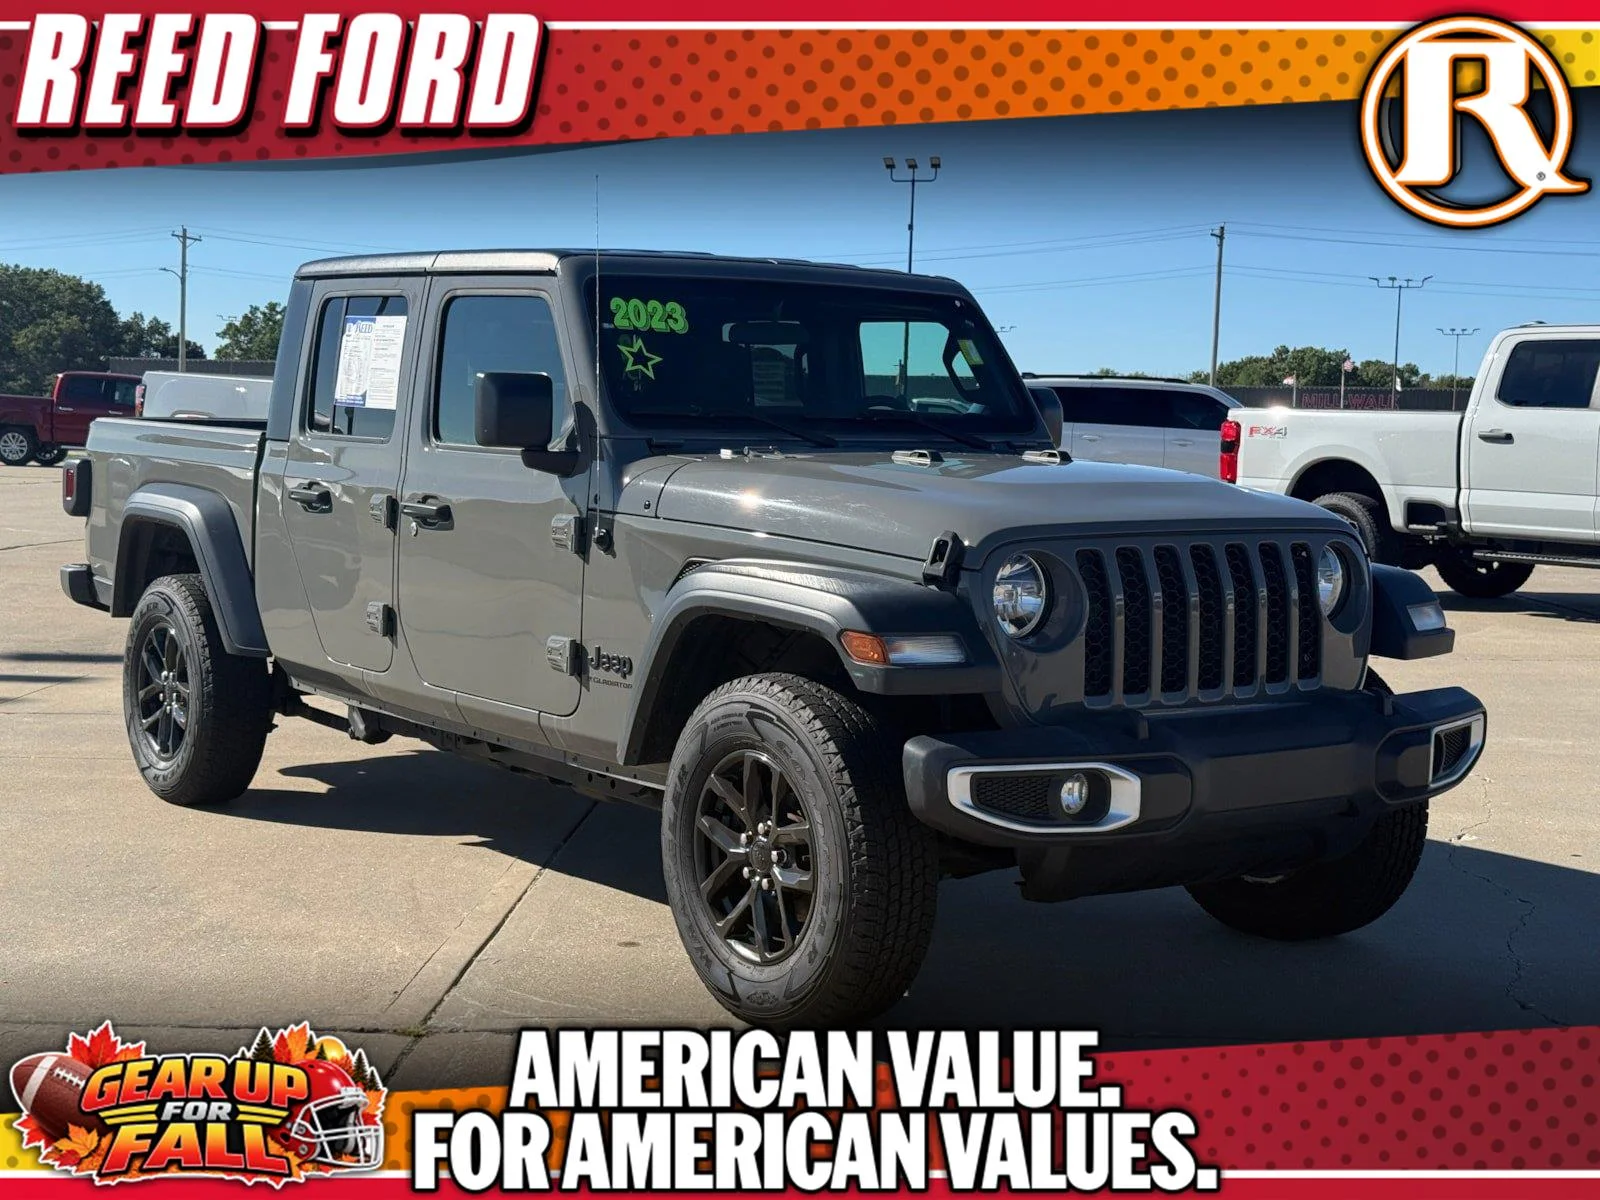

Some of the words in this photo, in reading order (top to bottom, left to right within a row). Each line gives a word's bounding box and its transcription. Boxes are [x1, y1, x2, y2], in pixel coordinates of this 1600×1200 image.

[610, 297, 689, 334] 2023
[1248, 425, 1288, 439] FX4
[587, 645, 633, 679] Jeep
[593, 676, 633, 689] GLADIATOR
